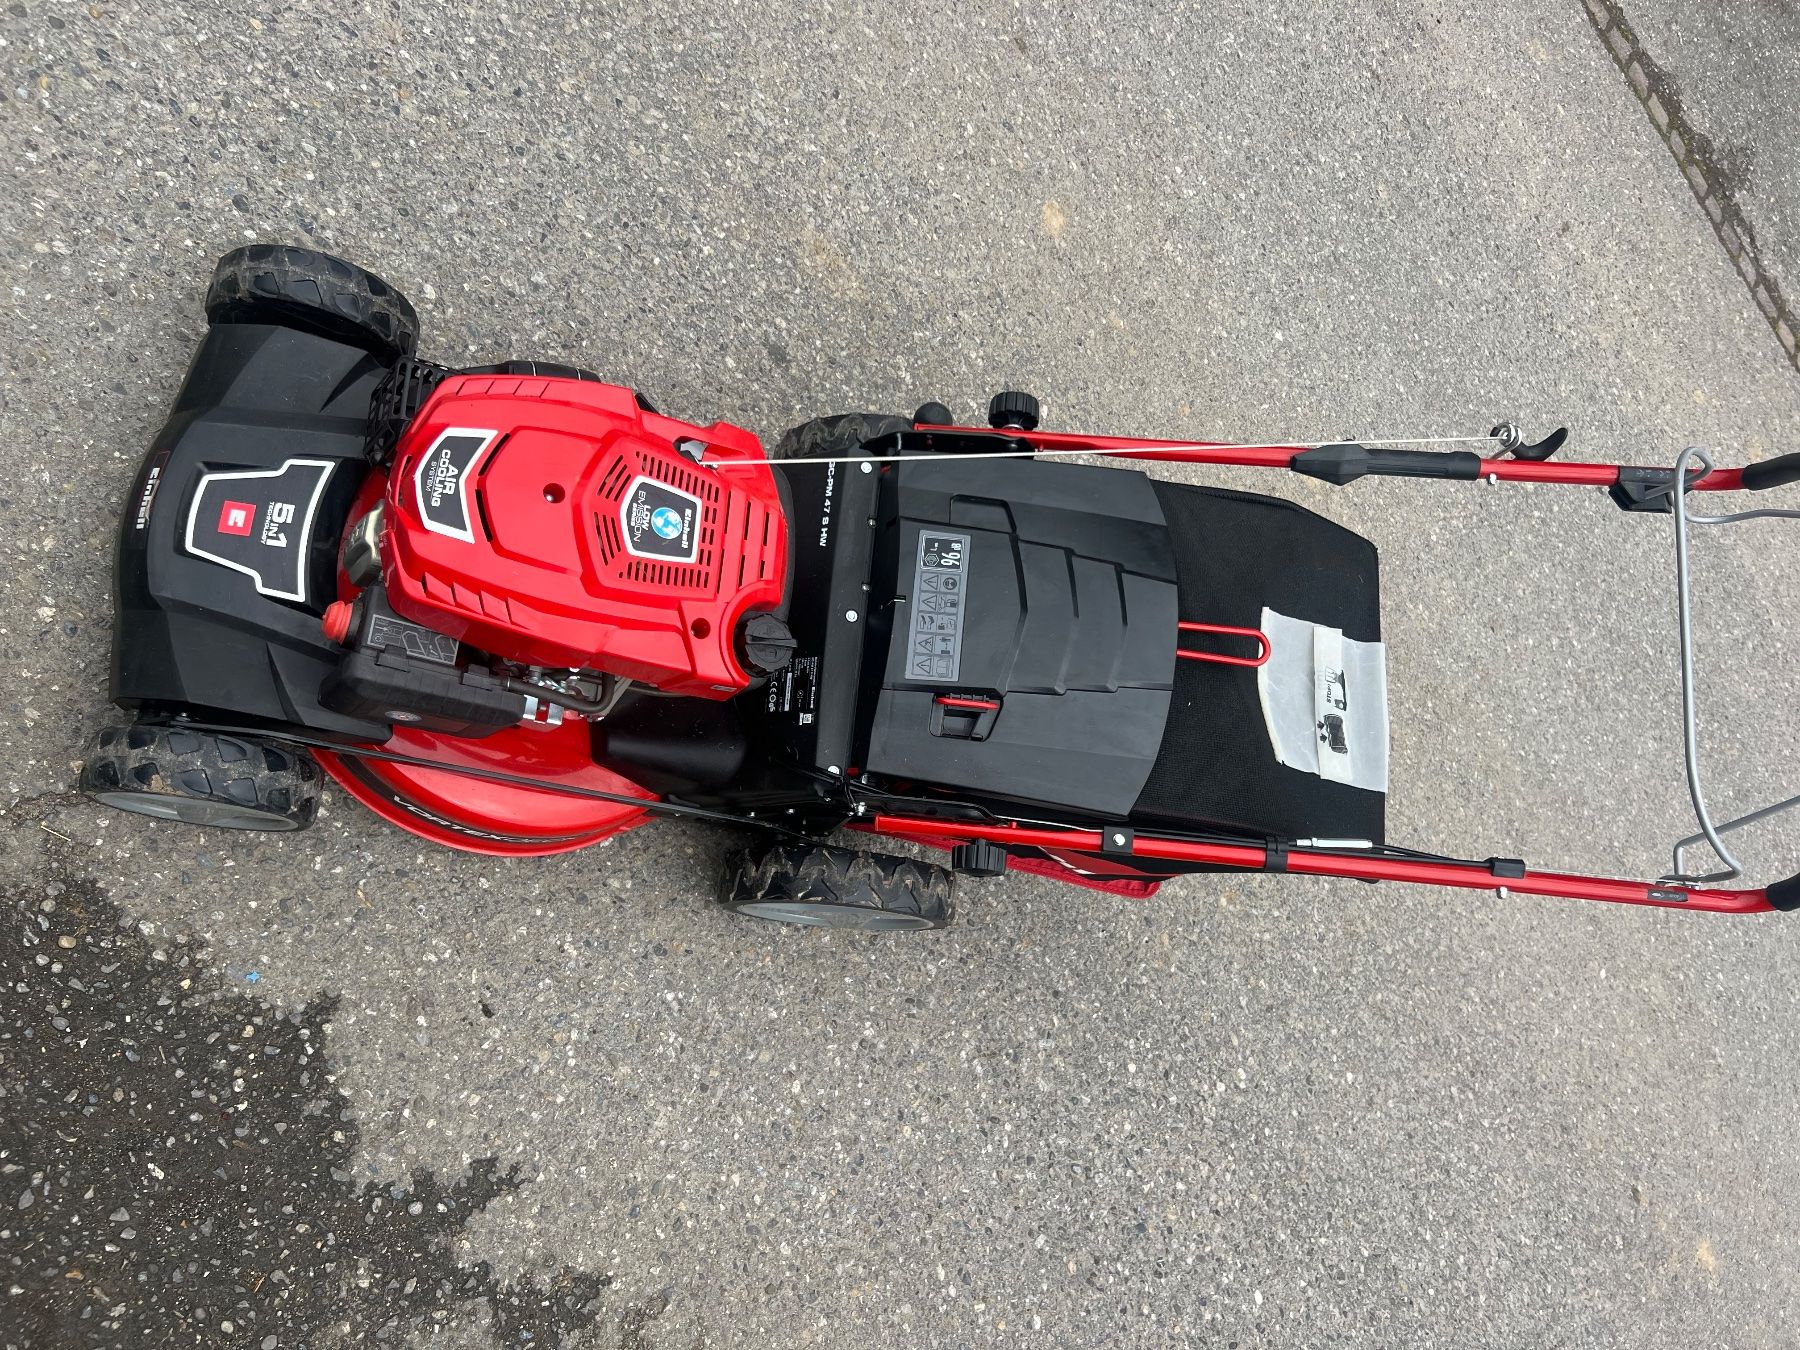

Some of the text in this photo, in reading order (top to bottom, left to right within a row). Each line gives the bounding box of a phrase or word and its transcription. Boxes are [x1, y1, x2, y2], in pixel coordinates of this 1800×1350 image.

[425, 461, 438, 492] SYSTEM
[431, 449, 451, 508] COOLING
[443, 464, 459, 495] AIR
[136, 467, 161, 530] Einhell
[633, 490, 647, 543] EMISSION
[823, 499, 831, 514] 47
[260, 501, 275, 545] TECHNOLOGY
[641, 504, 652, 531] LOW
[681, 508, 692, 549] Einhell
[819, 527, 829, 547] HW
[940, 552, 961, 566] 96
[393, 794, 502, 841] VORTEX
